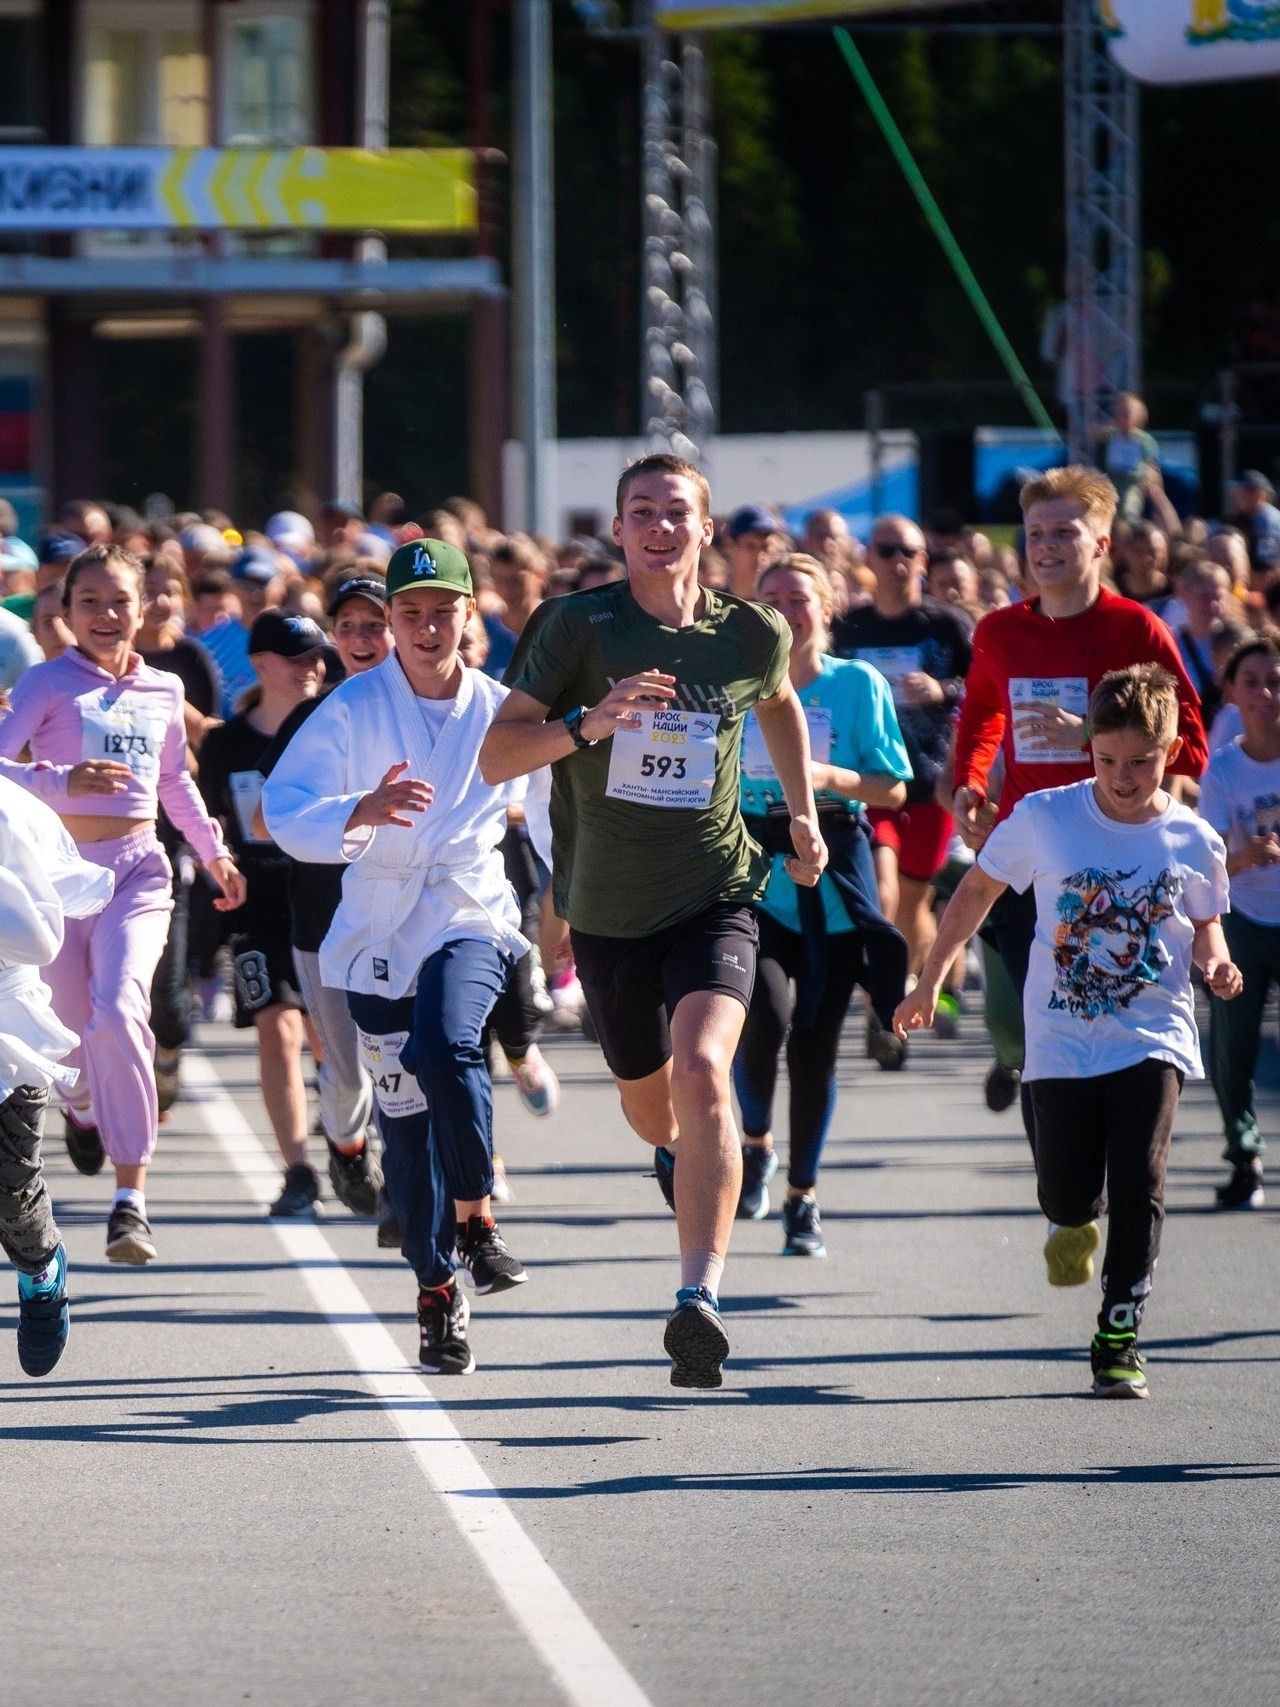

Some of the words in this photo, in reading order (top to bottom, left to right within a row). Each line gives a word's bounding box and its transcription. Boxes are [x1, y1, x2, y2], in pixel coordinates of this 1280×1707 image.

[412, 547, 437, 575] LA
[654, 711, 681, 721] КРОСС
[652, 720, 688, 733] НАЦИИ
[104, 733, 147, 755] 1273
[651, 731, 687, 745] 2023
[640, 753, 687, 780] 593
[612, 787, 665, 801] АВТОНОМНЫЙ
[665, 796, 707, 804] ОКРУГ-ЮГРА
[622, 782, 650, 793] ХАНТЫ-
[651, 788, 699, 797] МАНСИЙСКИЙ
